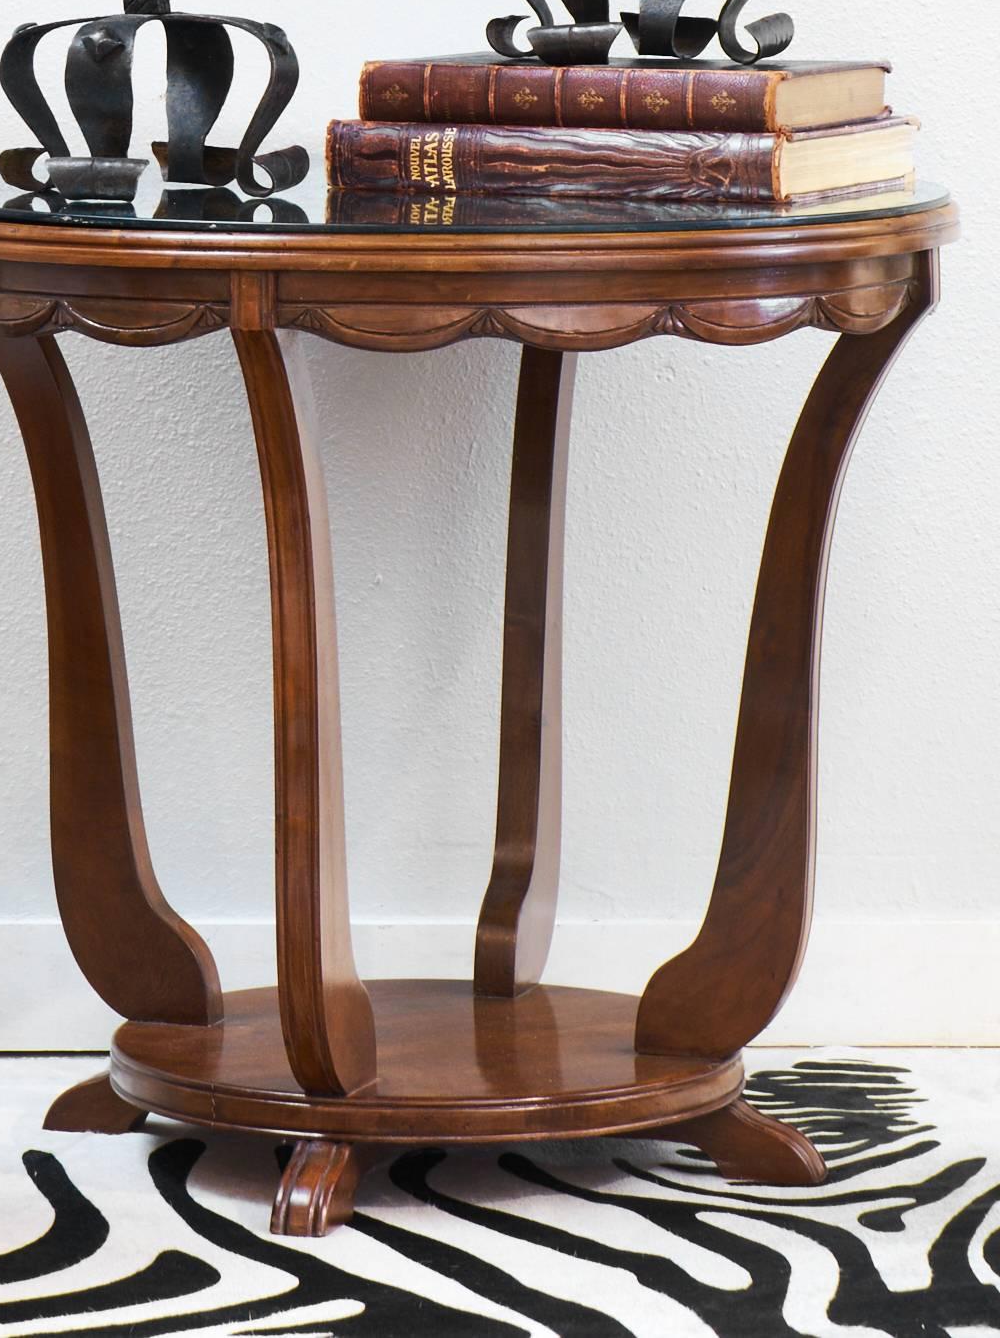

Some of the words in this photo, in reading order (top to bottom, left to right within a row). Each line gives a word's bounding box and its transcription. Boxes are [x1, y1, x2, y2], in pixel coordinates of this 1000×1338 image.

[410, 135, 422, 181] NOUVEL
[423, 132, 440, 188] ATLAS
[441, 127, 457, 190] LAROUSSE
